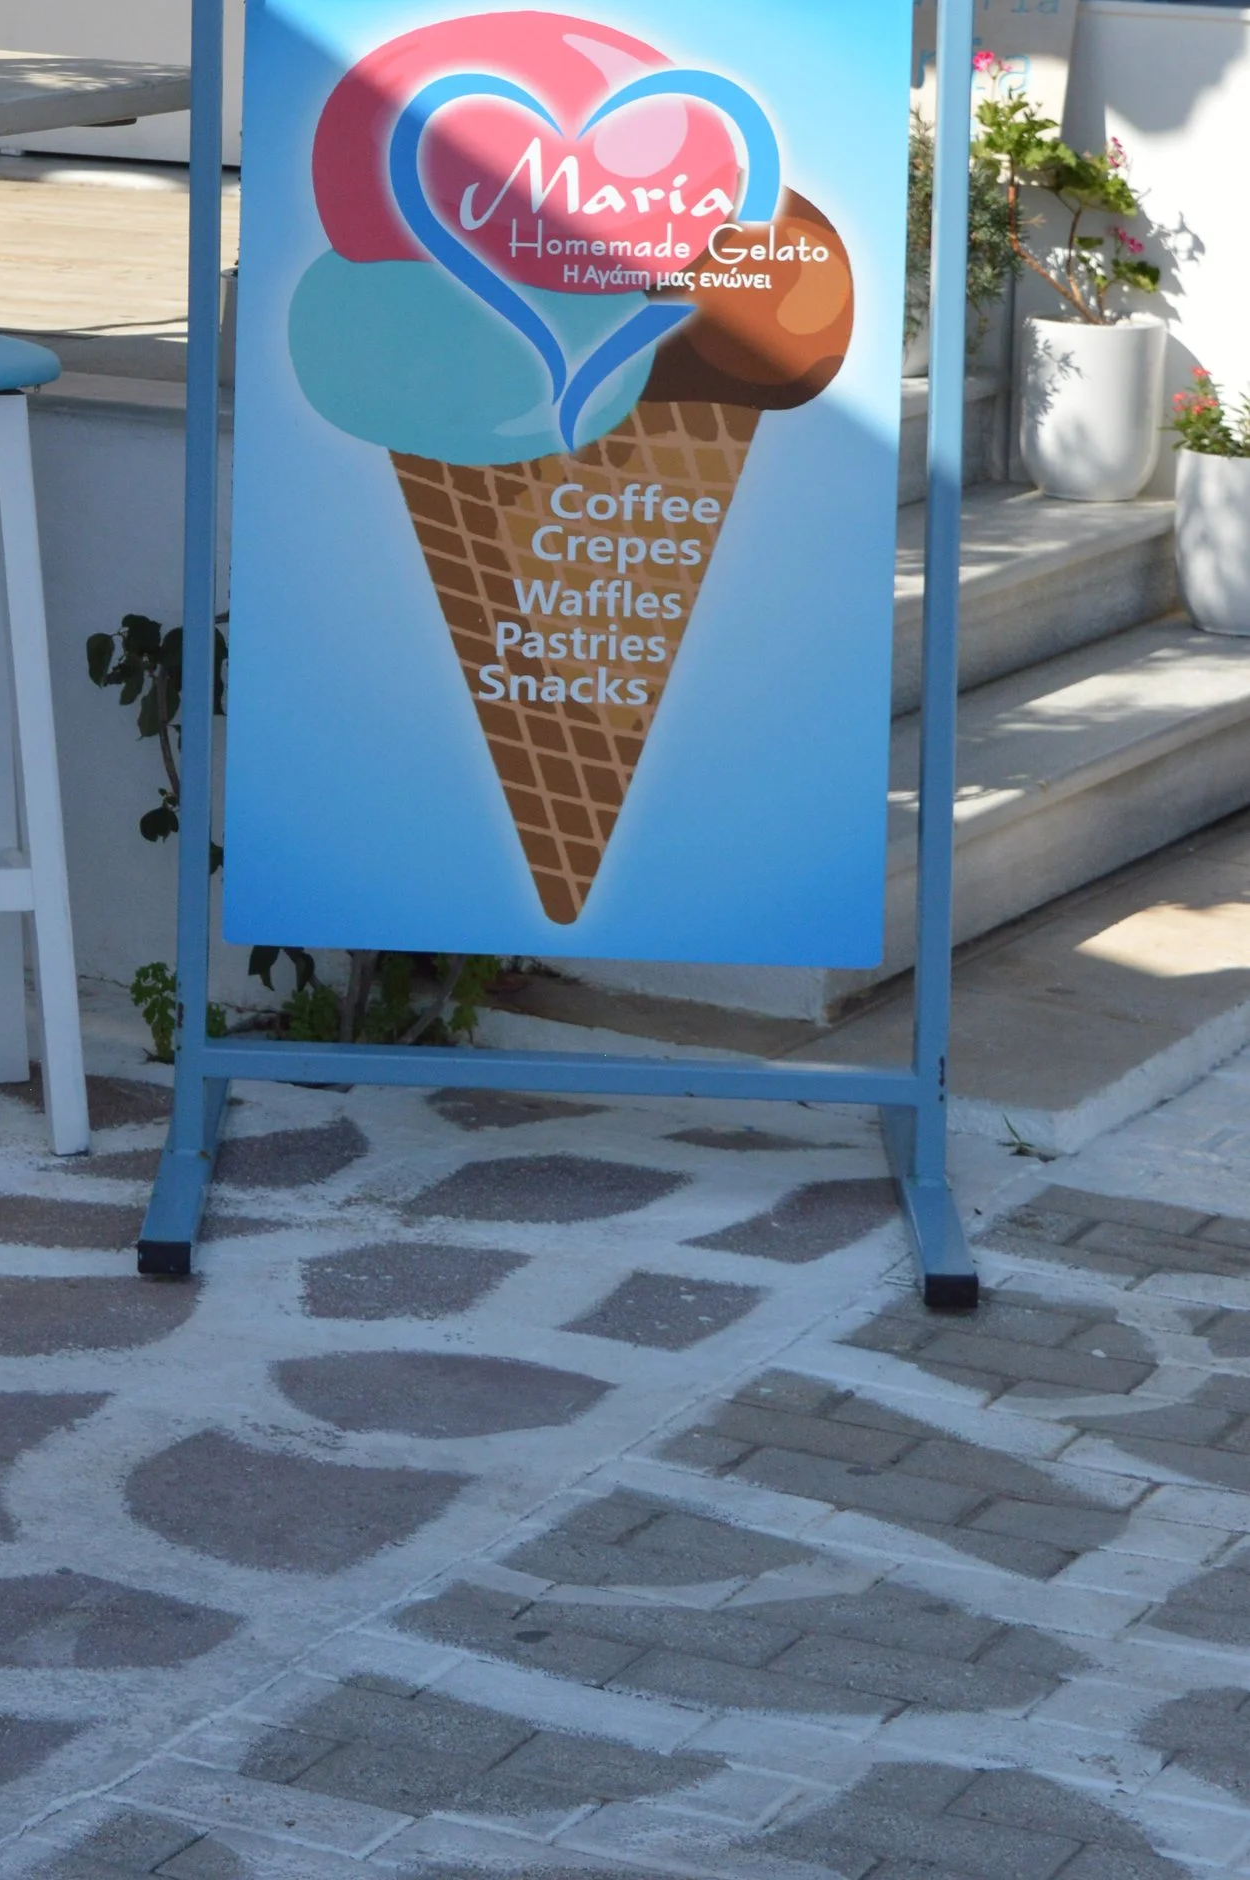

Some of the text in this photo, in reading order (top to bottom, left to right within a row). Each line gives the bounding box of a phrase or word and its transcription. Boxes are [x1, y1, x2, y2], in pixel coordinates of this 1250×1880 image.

[509, 218, 830, 265] Homemade Gelato
[583, 264, 651, 290] Αγάπη
[656, 271, 696, 290] μας
[699, 269, 772, 289] ενώνει
[550, 483, 721, 524] Coffee
[531, 525, 702, 574] Crepes
[513, 579, 682, 619] Waffles
[496, 621, 667, 662] Pastries
[477, 664, 649, 705] Snacks
